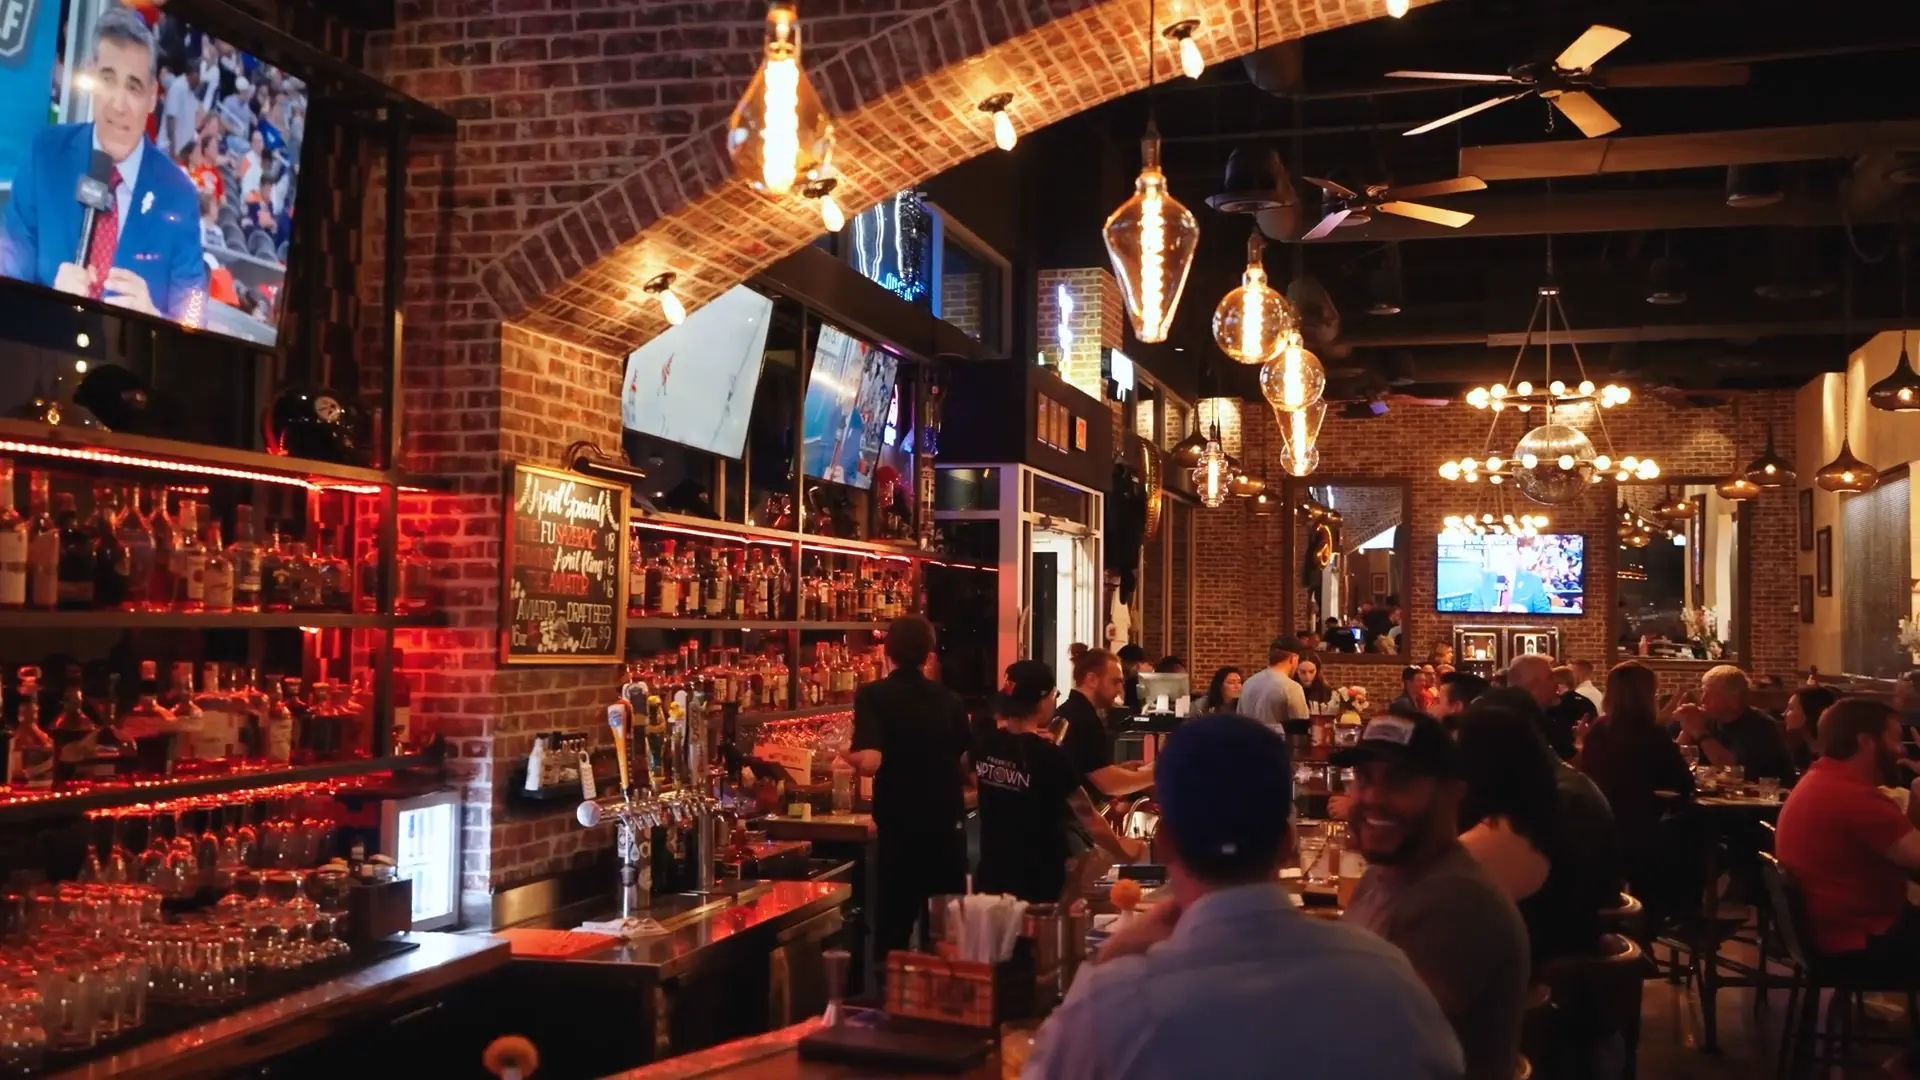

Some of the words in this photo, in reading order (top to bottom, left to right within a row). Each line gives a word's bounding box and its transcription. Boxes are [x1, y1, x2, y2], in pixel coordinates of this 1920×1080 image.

[528, 479, 564, 520] April
[541, 520, 556, 544] FU
[554, 546, 580, 572] April
[549, 572, 590, 596] AVIATOR
[516, 600, 557, 621] AVIATOR
[566, 602, 593, 623] DRAFT
[593, 604, 613, 624] BEER
